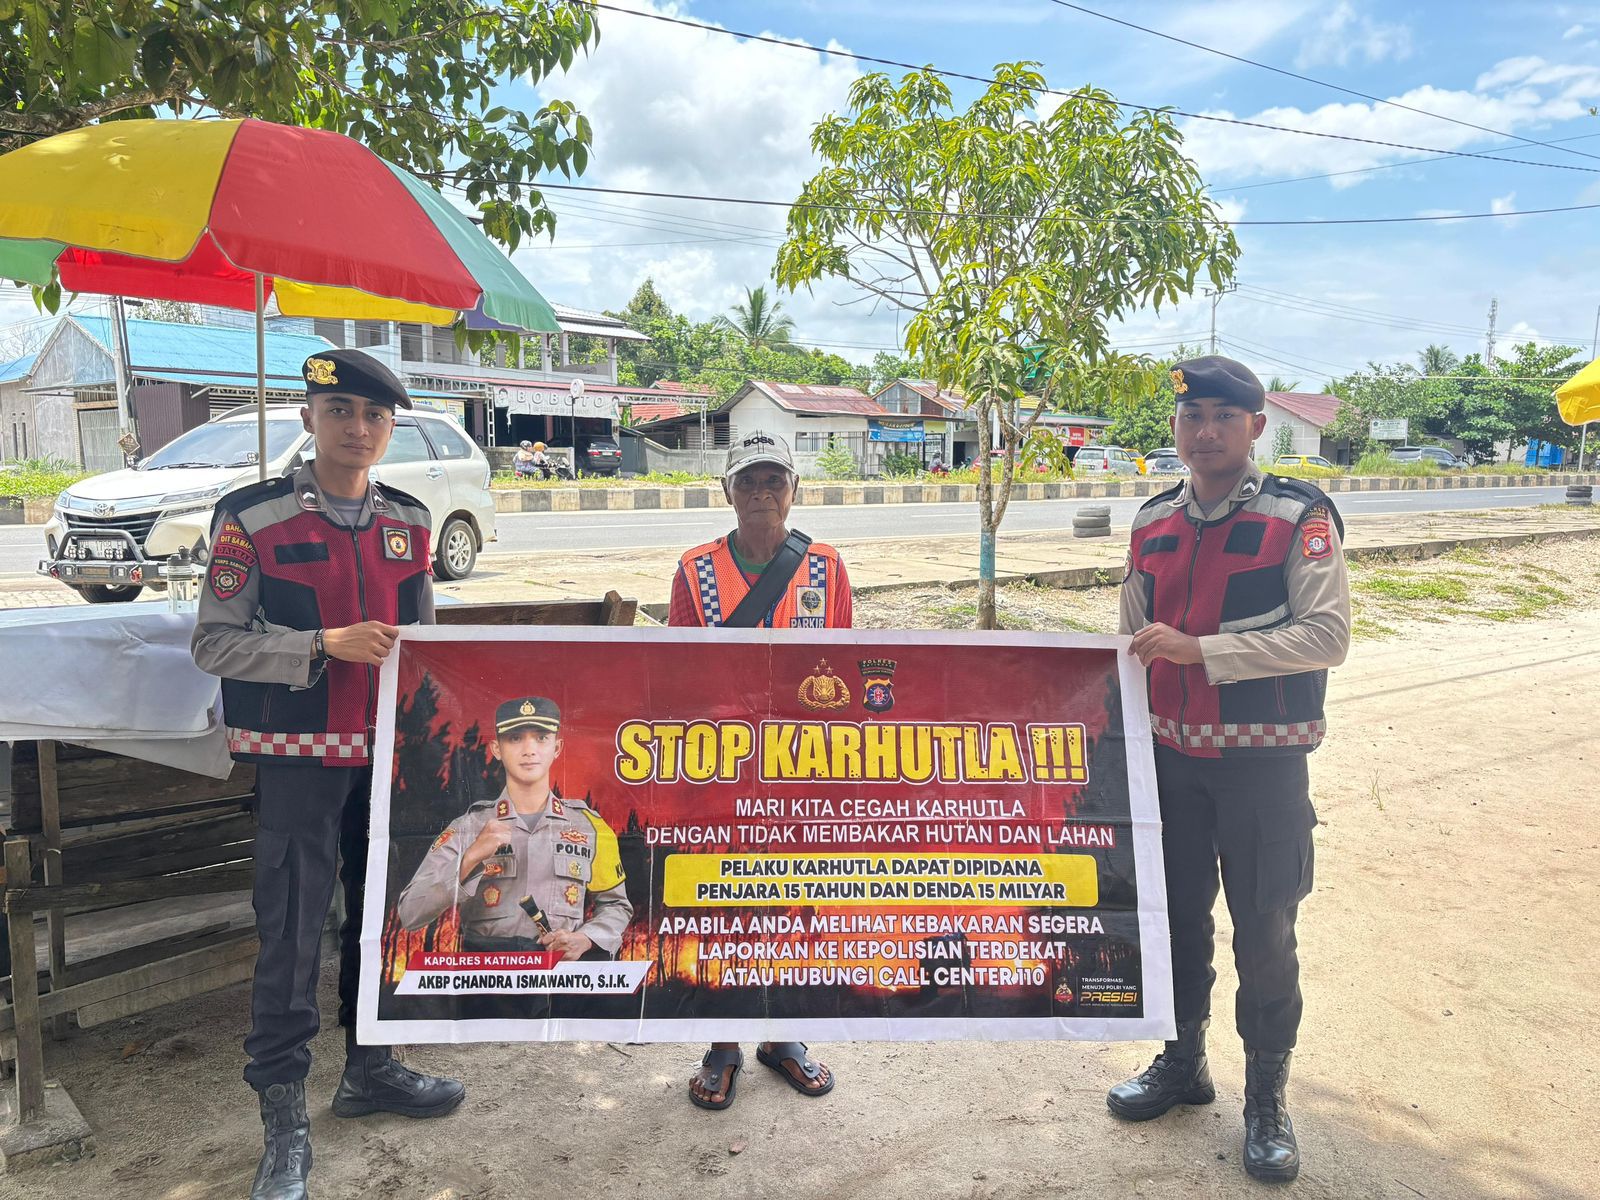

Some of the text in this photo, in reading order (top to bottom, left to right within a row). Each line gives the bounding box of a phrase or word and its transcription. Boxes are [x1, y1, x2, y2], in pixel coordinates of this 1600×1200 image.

[743, 436, 775, 448] BOSS
[790, 617, 825, 628] PARKIR
[618, 721, 1088, 783] STOP KARHUTLA !!!
[736, 798, 1026, 817] MARI KITA CEGAH KARHUTLA
[646, 824, 1114, 846] DENGAN TIDAK MEMBAKAR HUTAN DAN LAHAN
[556, 843, 591, 859] POLRI
[720, 859, 1043, 876] PELAKU KARHUTLA DAPAT DIPIDANA
[697, 882, 1066, 900] PENJARA 15 TAHUN DAN DENDA 15 MILYAR
[658, 915, 1105, 935] APABILA ANDA MELIHAT KEBAKARAN SEGERA
[698, 940, 1067, 961] LAPORKAN KE KEPOLISIAN TERDEKAT
[424, 954, 542, 967] KAPOLRES KATINGAN
[417, 973, 630, 991] AKBP CHANDRA ISMAWANTO, S.I.K.
[721, 966, 1045, 987] ATAU HUBUNGI CALL CENTER 110
[1080, 991, 1138, 1003] PRESISI
